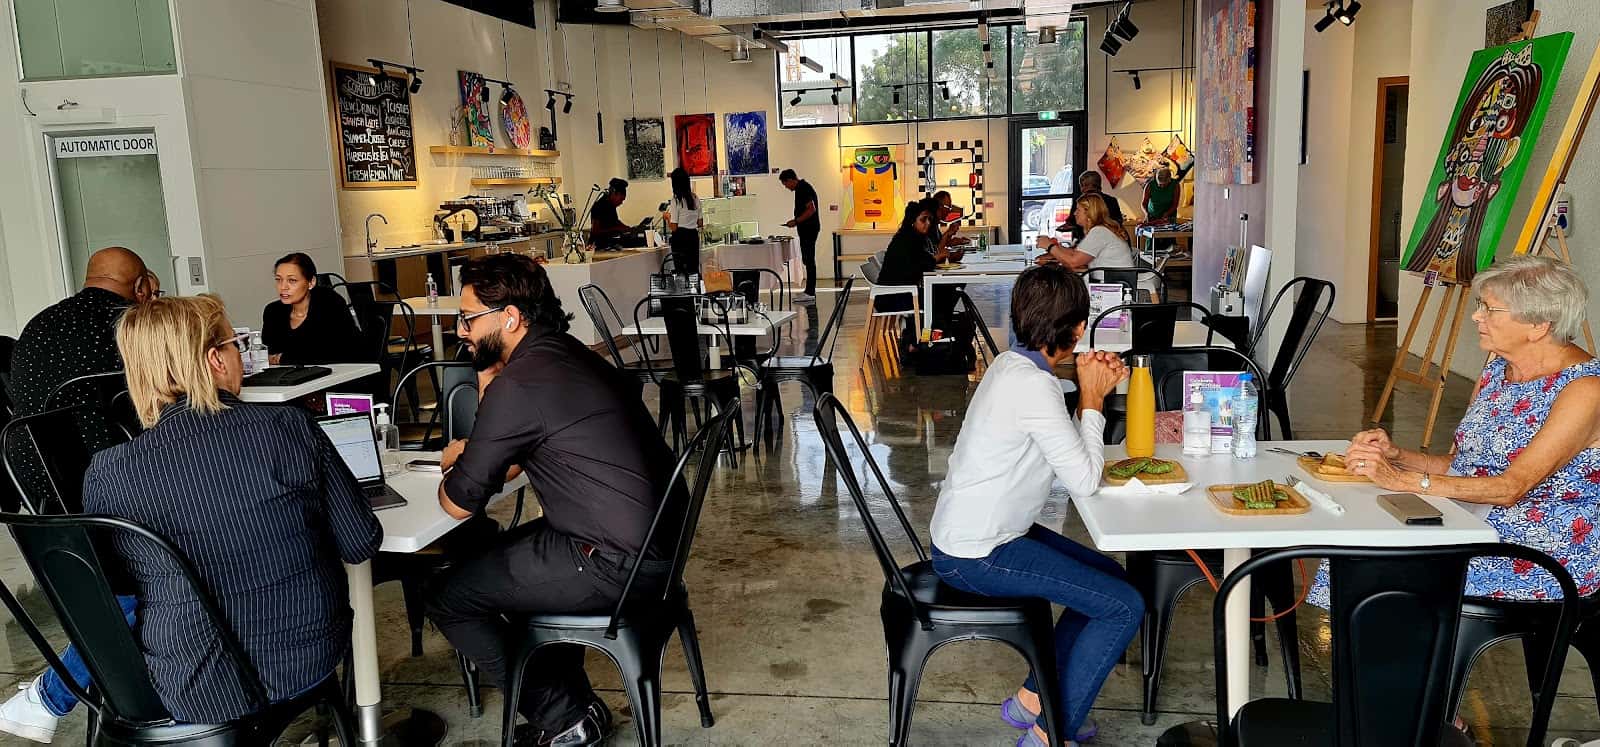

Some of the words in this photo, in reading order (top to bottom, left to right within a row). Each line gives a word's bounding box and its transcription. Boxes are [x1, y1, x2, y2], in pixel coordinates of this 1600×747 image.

[344, 130, 366, 144] SUMMER
[60, 139, 121, 153] AUTOMATIC
[123, 138, 154, 150] DOOR
[377, 145, 389, 161] TEA
[347, 165, 368, 181] FRESH
[368, 163, 387, 181] LEMON
[387, 164, 404, 180] MINT
